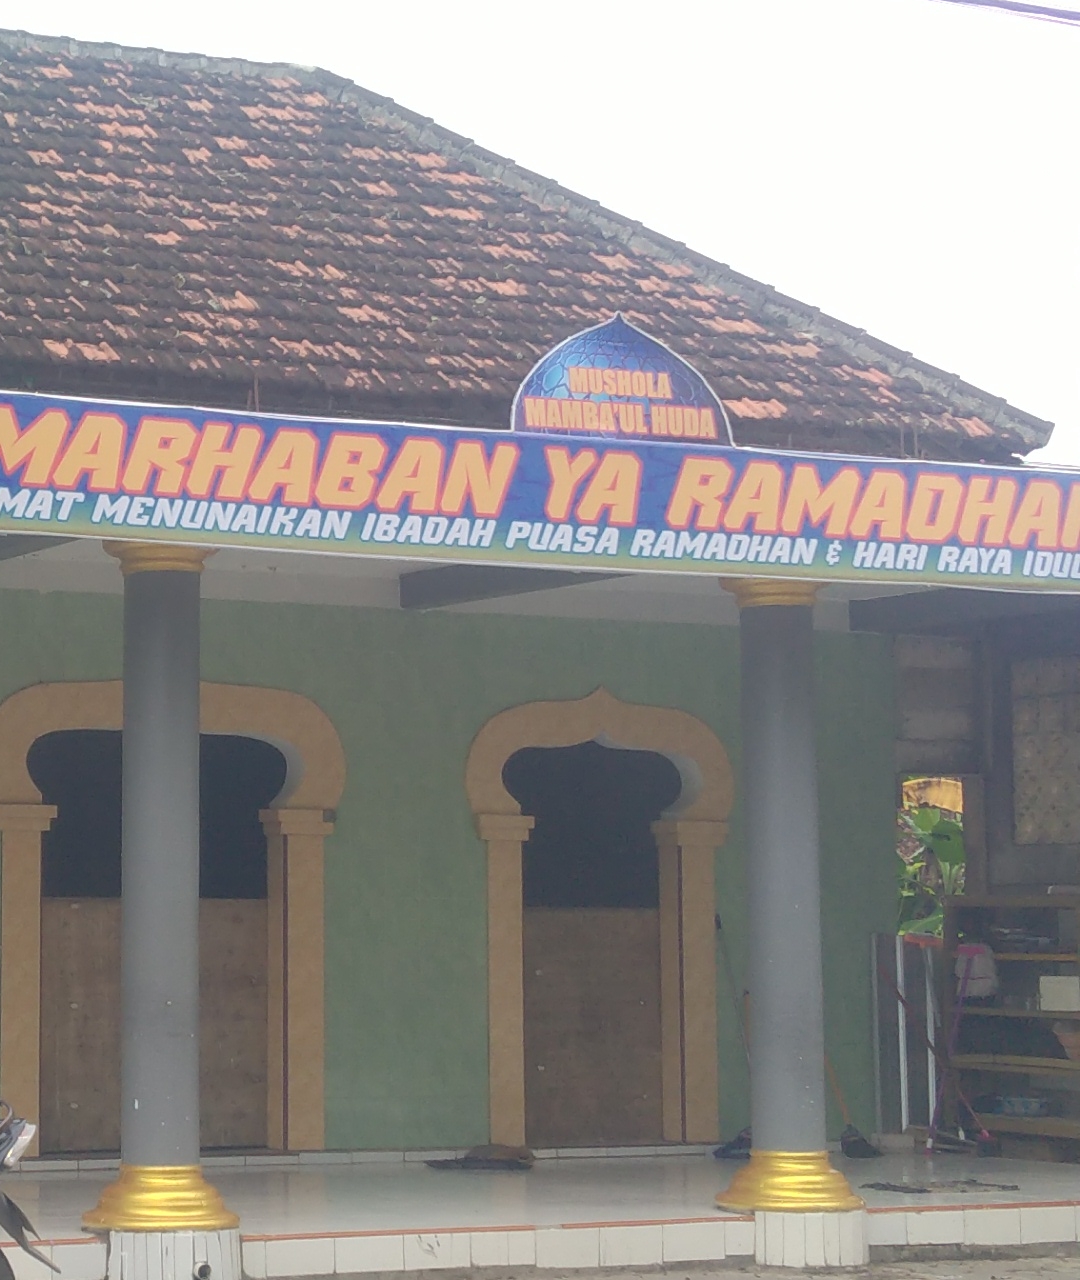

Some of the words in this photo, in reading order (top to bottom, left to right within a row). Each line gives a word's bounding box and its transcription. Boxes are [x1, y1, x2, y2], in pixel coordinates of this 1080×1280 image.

[568, 366, 672, 399] MUSHOLA
[524, 396, 648, 434] MAMBA'UL
[650, 404, 718, 439] HUDA
[545, 446, 644, 527] YA
[91, 493, 352, 540] MENUNAIKAN
[360, 512, 497, 548] IBADAH
[505, 520, 619, 555] PUASA
[629, 528, 818, 565] RAMADHAN
[825, 539, 842, 566] &
[852, 541, 926, 571] HARI
[937, 545, 1012, 575] RAYA
